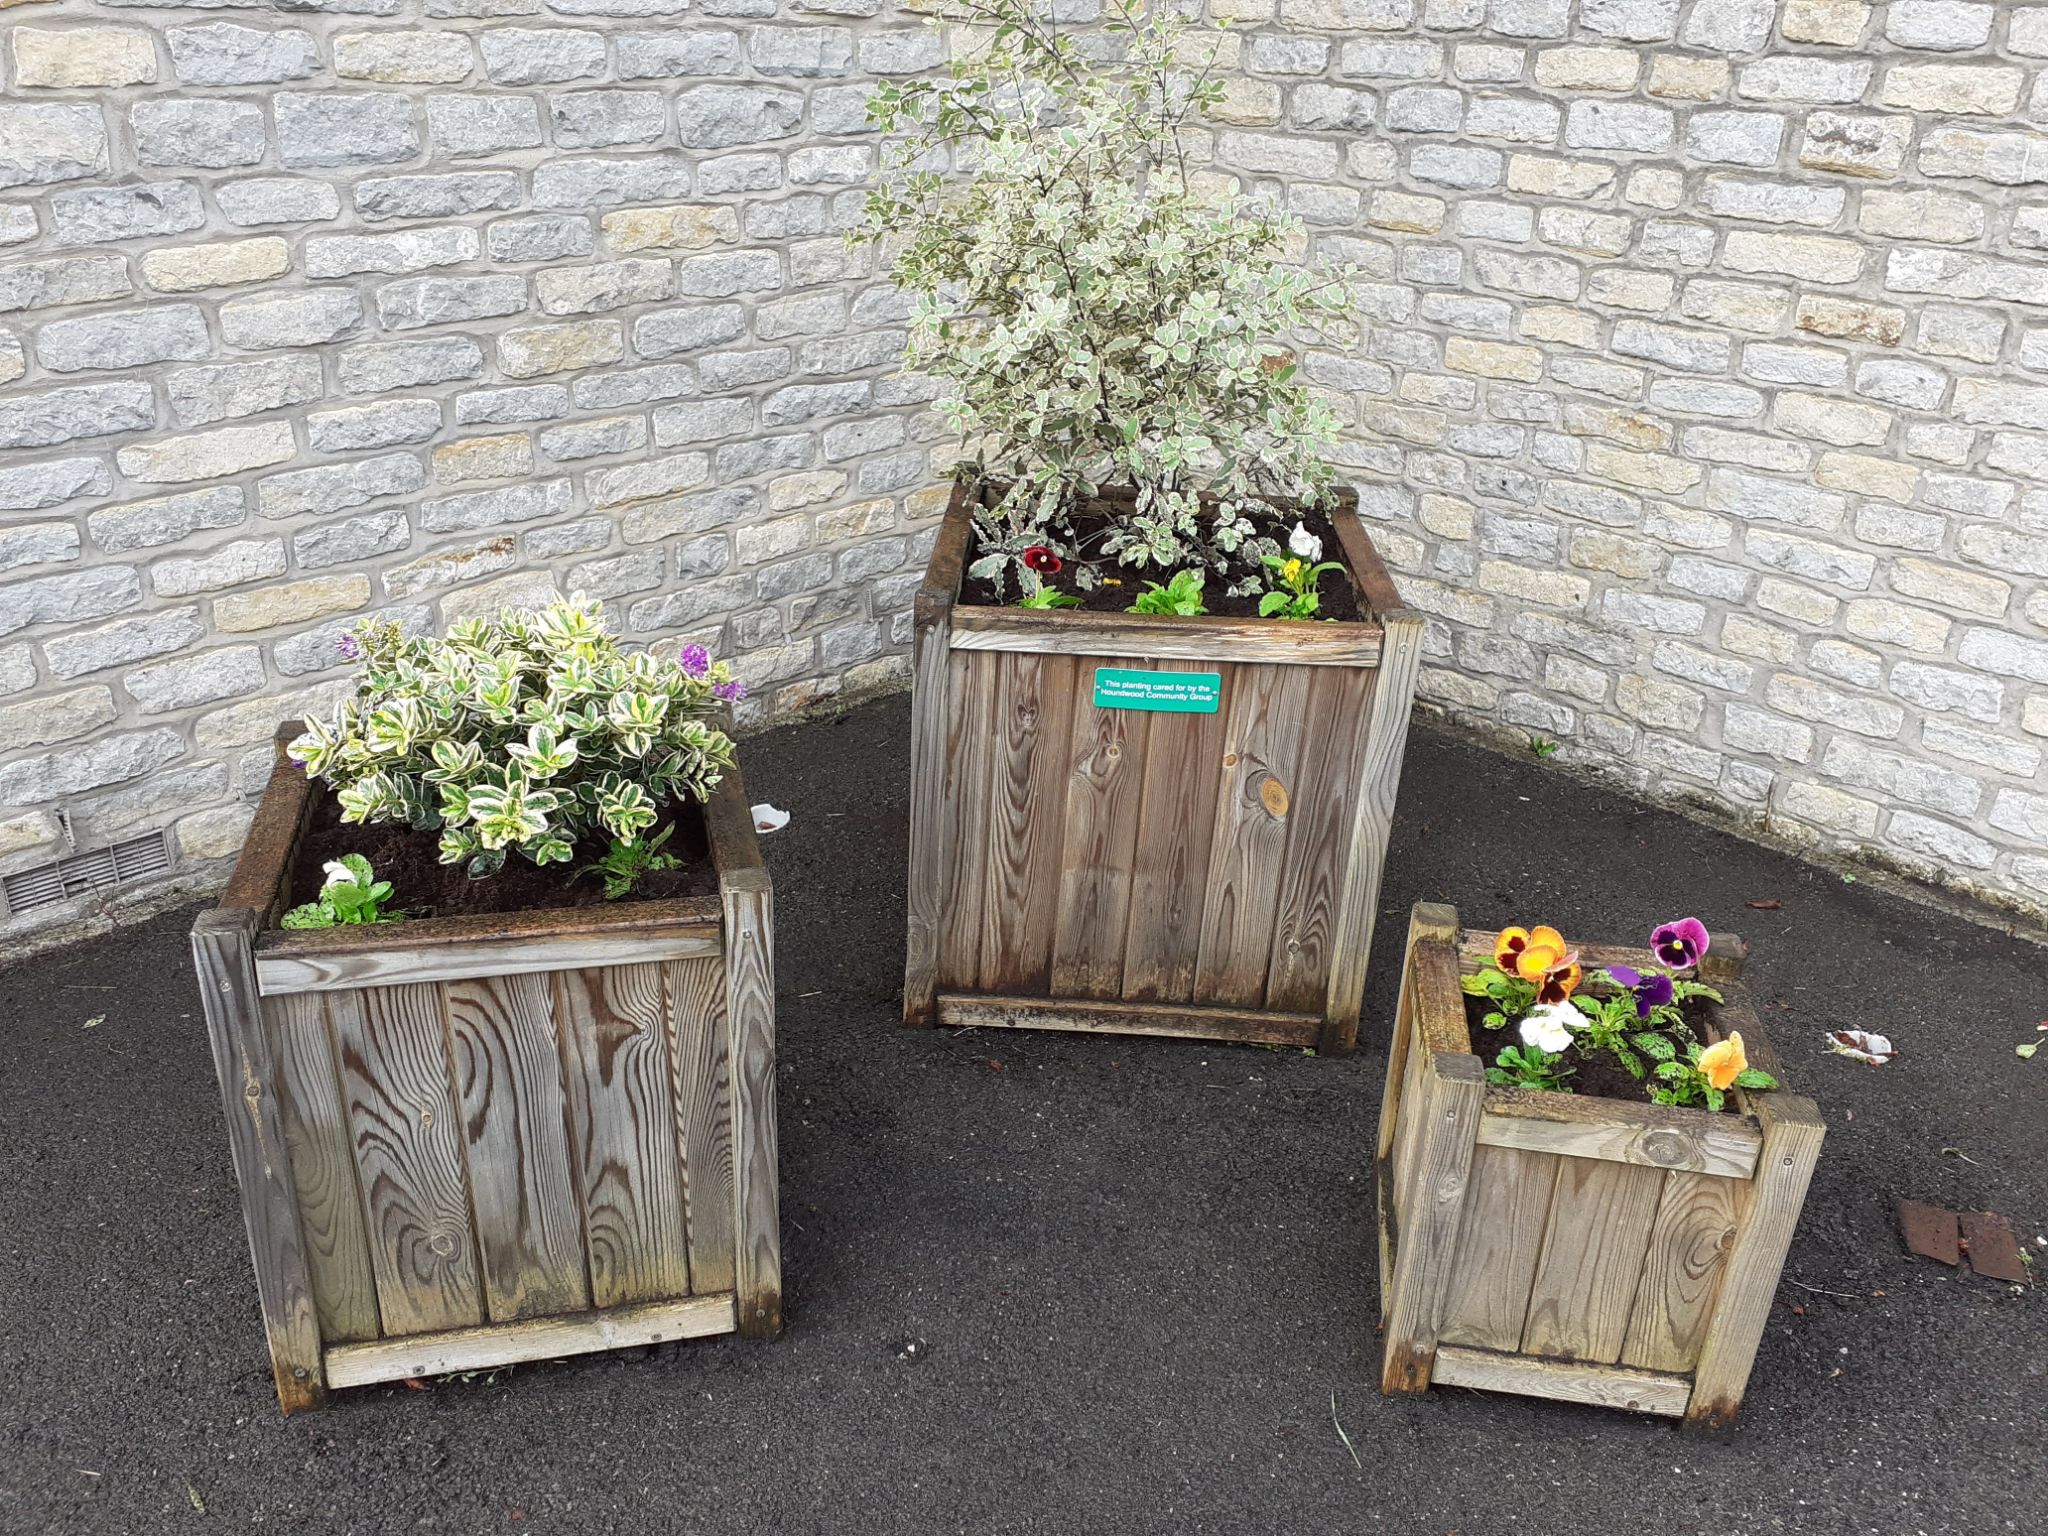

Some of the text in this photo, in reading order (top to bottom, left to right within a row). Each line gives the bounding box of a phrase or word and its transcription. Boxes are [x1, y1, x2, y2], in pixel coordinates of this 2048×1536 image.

[1122, 682, 1151, 691] planting
[1188, 684, 1197, 692] by
[1146, 692, 1188, 701] Community
